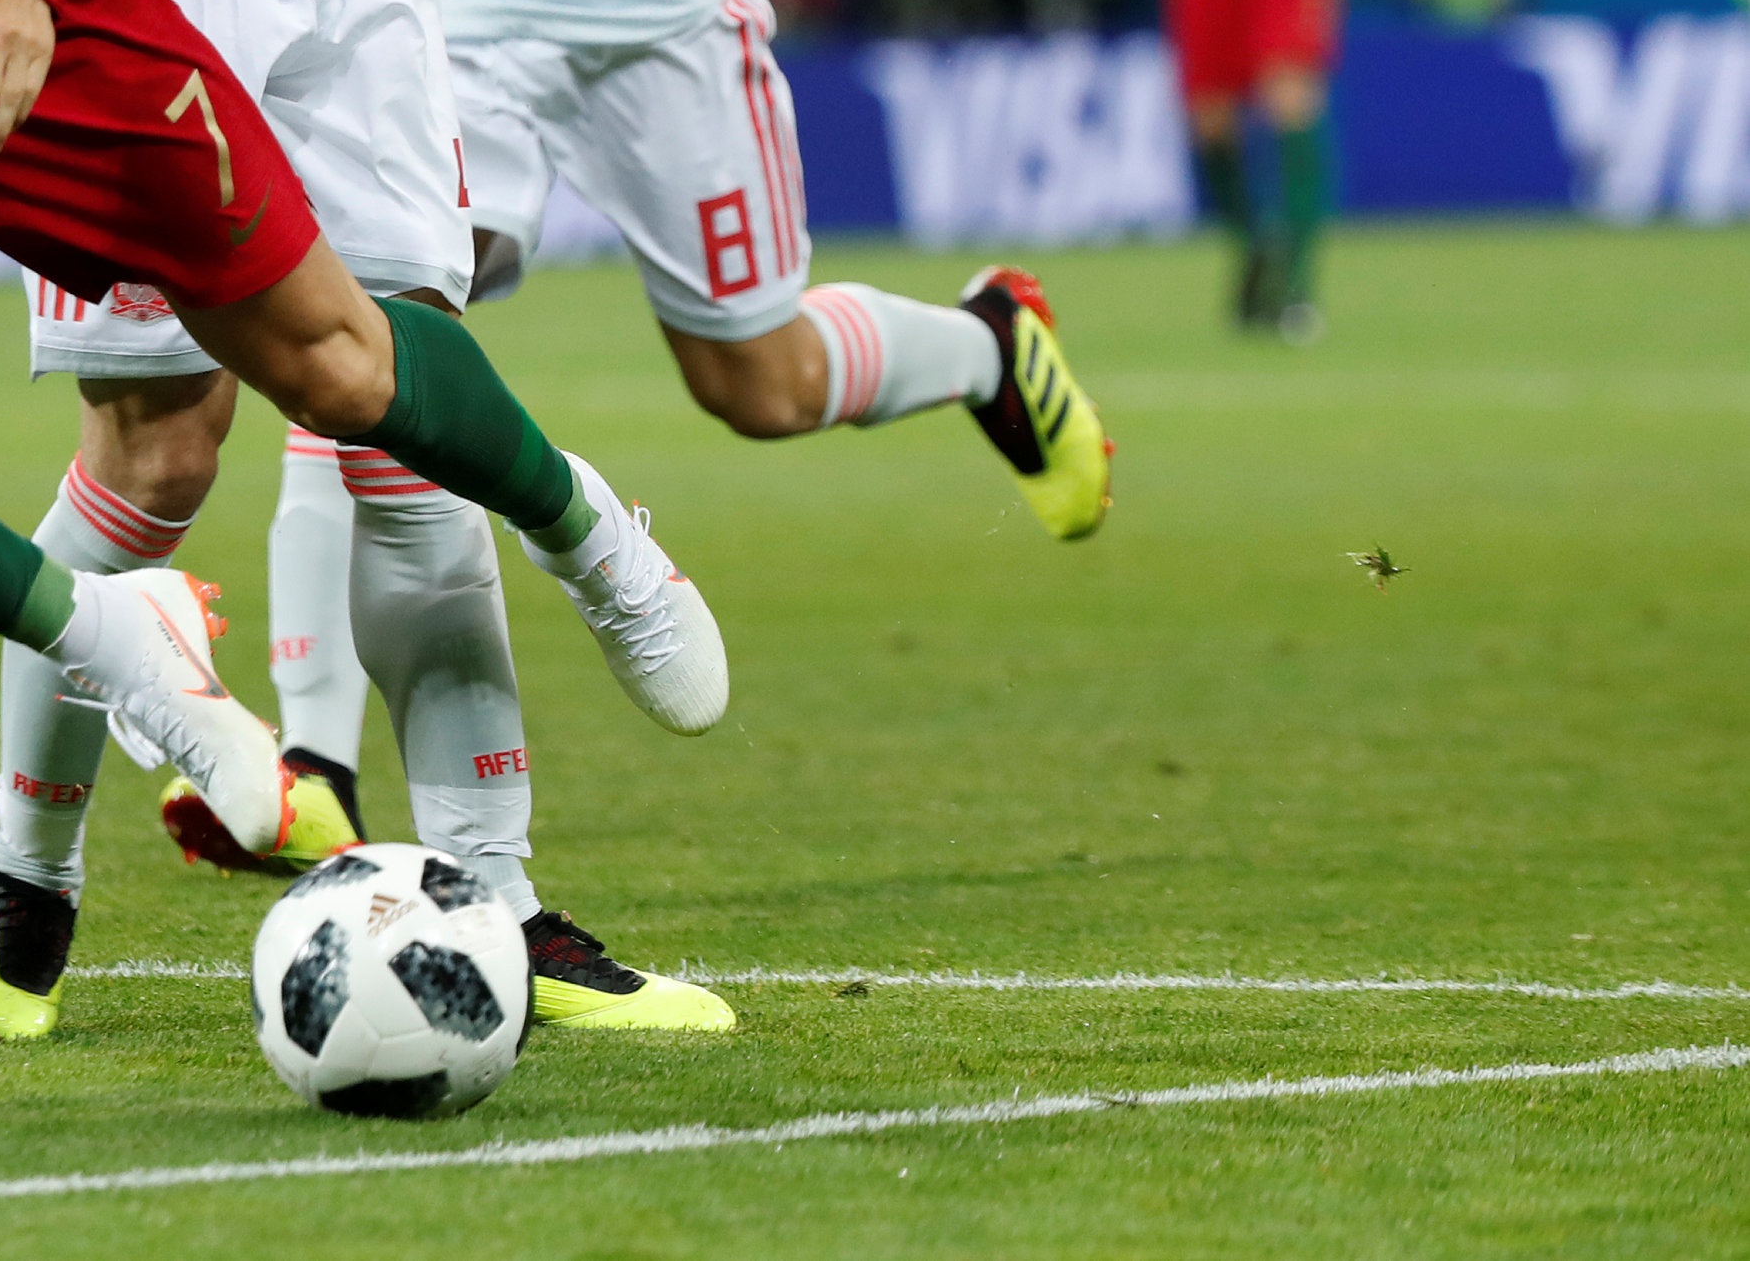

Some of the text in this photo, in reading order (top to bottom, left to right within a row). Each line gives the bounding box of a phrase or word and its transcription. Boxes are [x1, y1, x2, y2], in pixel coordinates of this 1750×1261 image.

[164, 68, 235, 208] 7
[697, 189, 759, 301] 8
[473, 747, 529, 779] RFE
